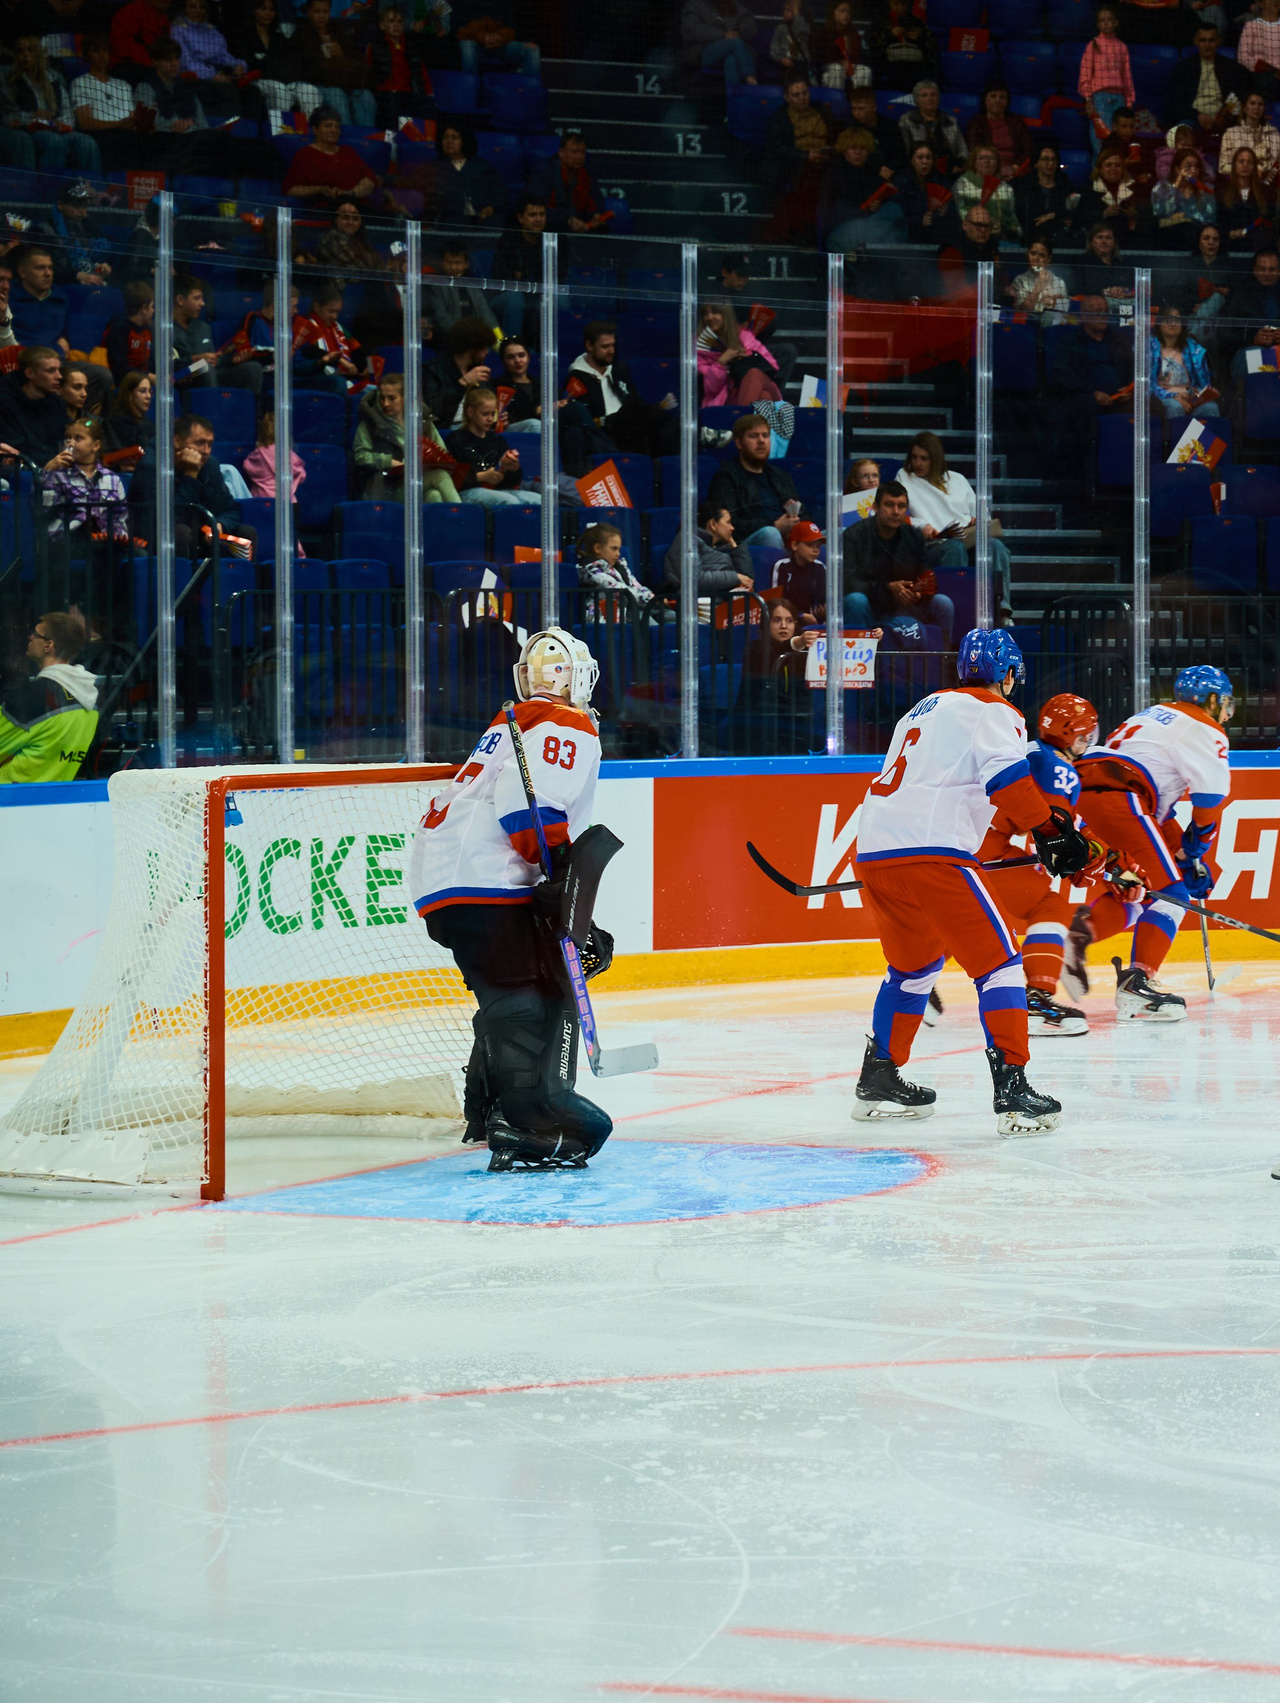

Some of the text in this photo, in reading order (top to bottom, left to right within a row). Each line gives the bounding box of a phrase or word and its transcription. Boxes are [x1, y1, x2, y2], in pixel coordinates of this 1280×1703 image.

[634, 73, 662, 95] 14
[674, 133, 702, 155] 13
[720, 191, 749, 214] 12
[767, 256, 790, 281] 11
[542, 735, 577, 771] 83
[1054, 766, 1079, 795] 32
[146, 832, 417, 940] OCKE
[565, 941, 593, 1034] BAUER
[559, 1019, 573, 1080] SUPREME
